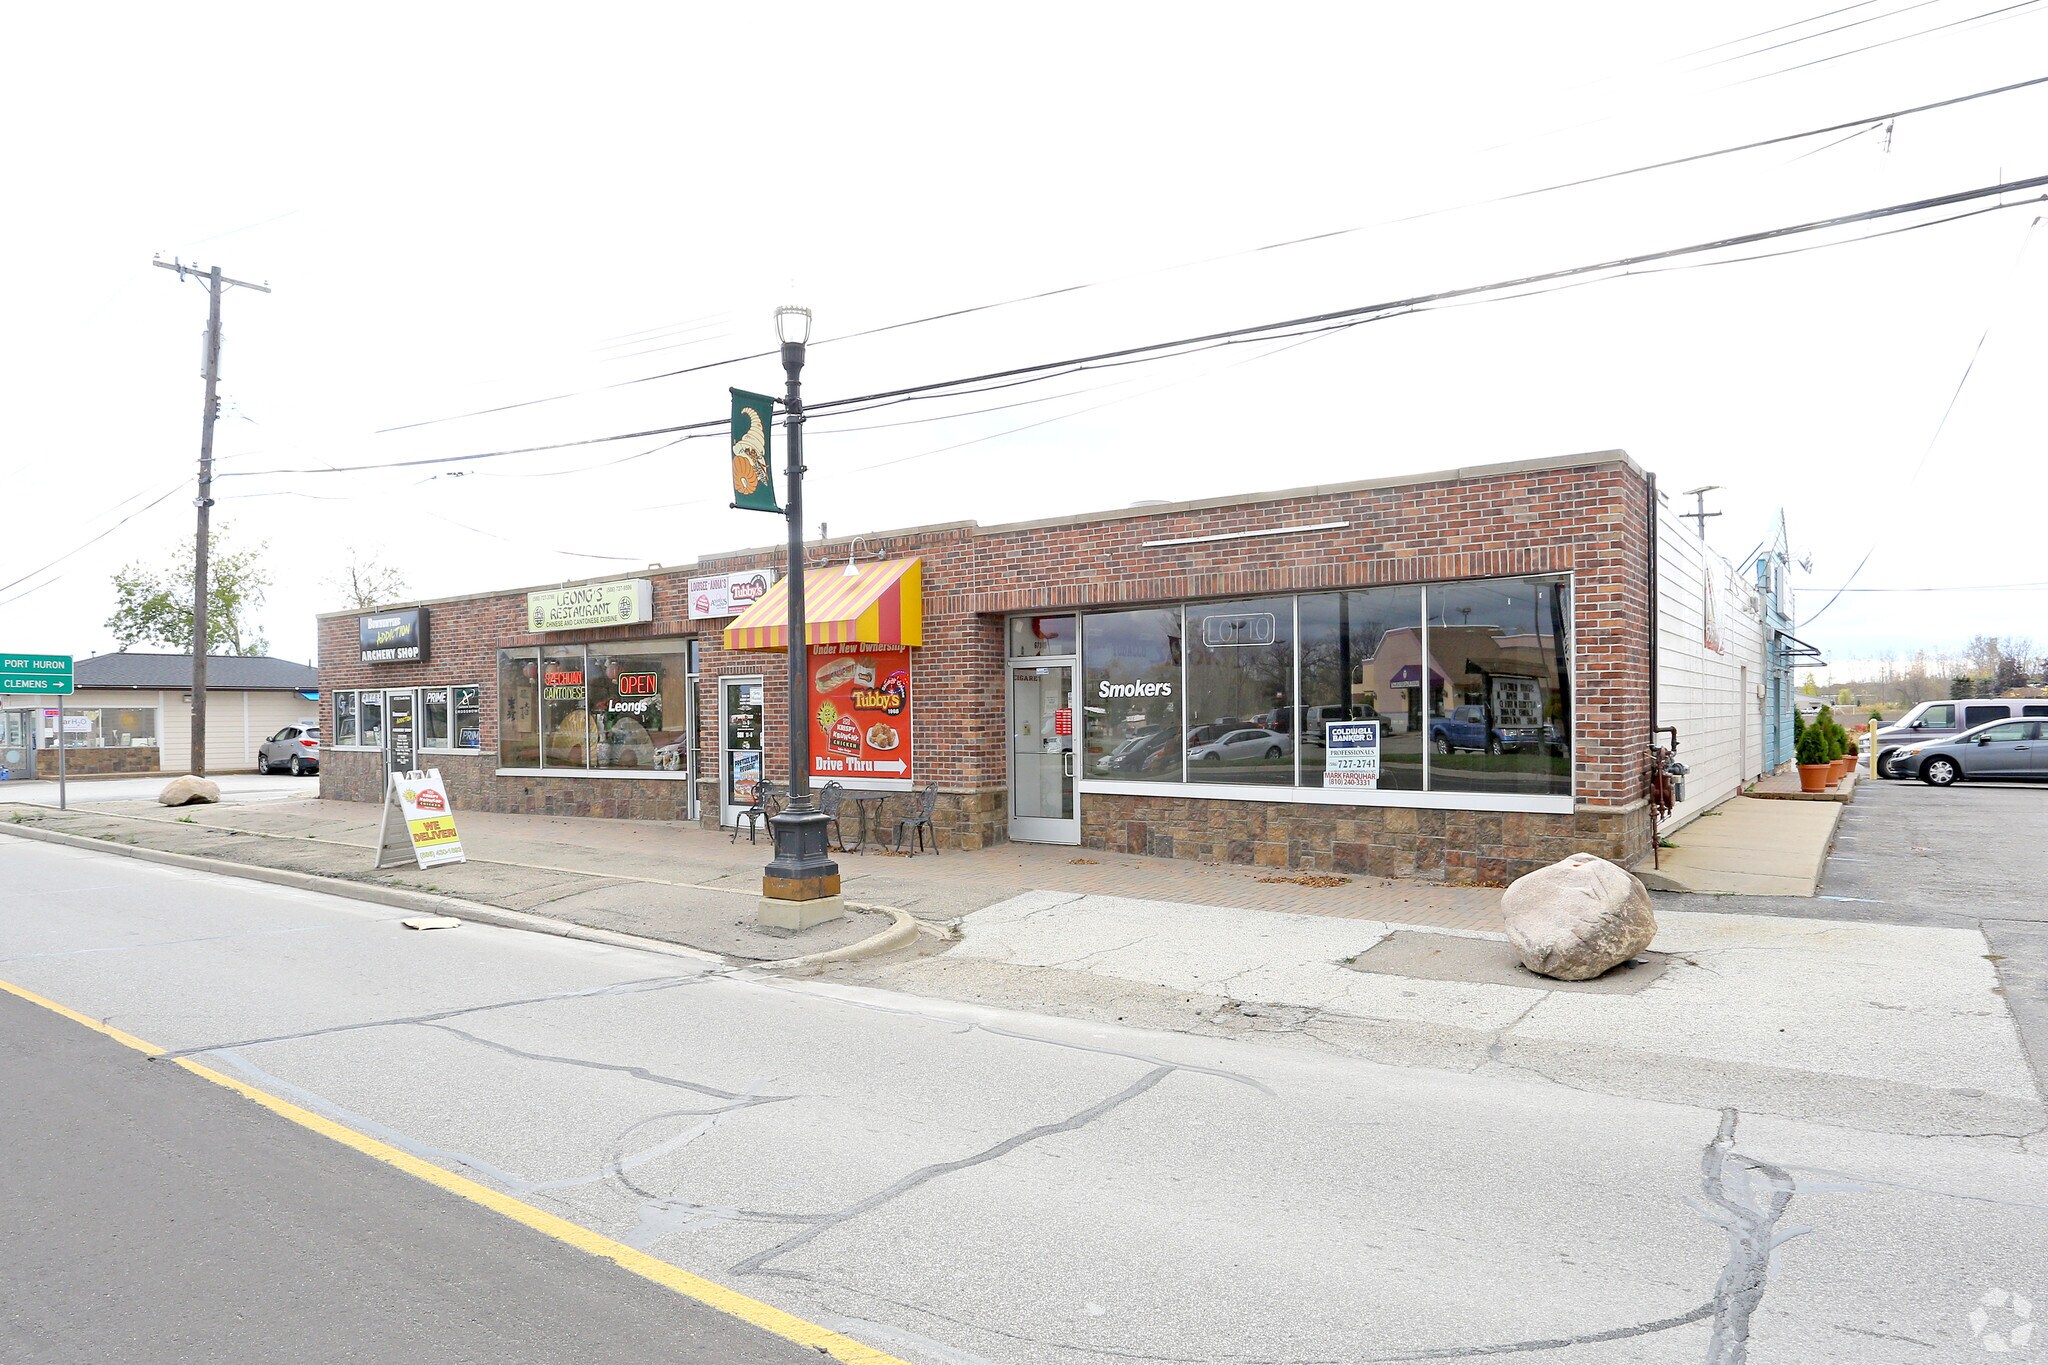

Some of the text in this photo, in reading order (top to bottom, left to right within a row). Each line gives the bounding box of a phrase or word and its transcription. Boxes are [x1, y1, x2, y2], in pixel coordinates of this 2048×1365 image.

[556, 587, 603, 607] LEONG'S
[732, 583, 763, 599] Tubby's
[550, 602, 611, 620] RESTAURANT
[546, 615, 618, 628] CHINESE AND CANTONESE CUISINE
[361, 646, 419, 661] ARCHERY SHOP
[813, 644, 837, 655] Under
[839, 643, 858, 654] New
[4, 659, 65, 669] PORT HURON
[4, 679, 48, 689] CLEMENS
[620, 675, 656, 694] OPEN
[1098, 680, 1172, 698] Smokers
[426, 692, 447, 703] PRIME
[853, 691, 900, 709] Tubby's
[608, 700, 648, 715] Leongs
[462, 730, 480, 740] PRIM
[1332, 727, 1373, 735] COLDWELL
[833, 739, 857, 749] CHICKEN
[1332, 734, 1366, 742] BANKER
[815, 757, 873, 771] Drive Thru
[1338, 759, 1376, 769] 727-2741
[423, 821, 441, 831] WE
[413, 828, 457, 842] DELIVER!
